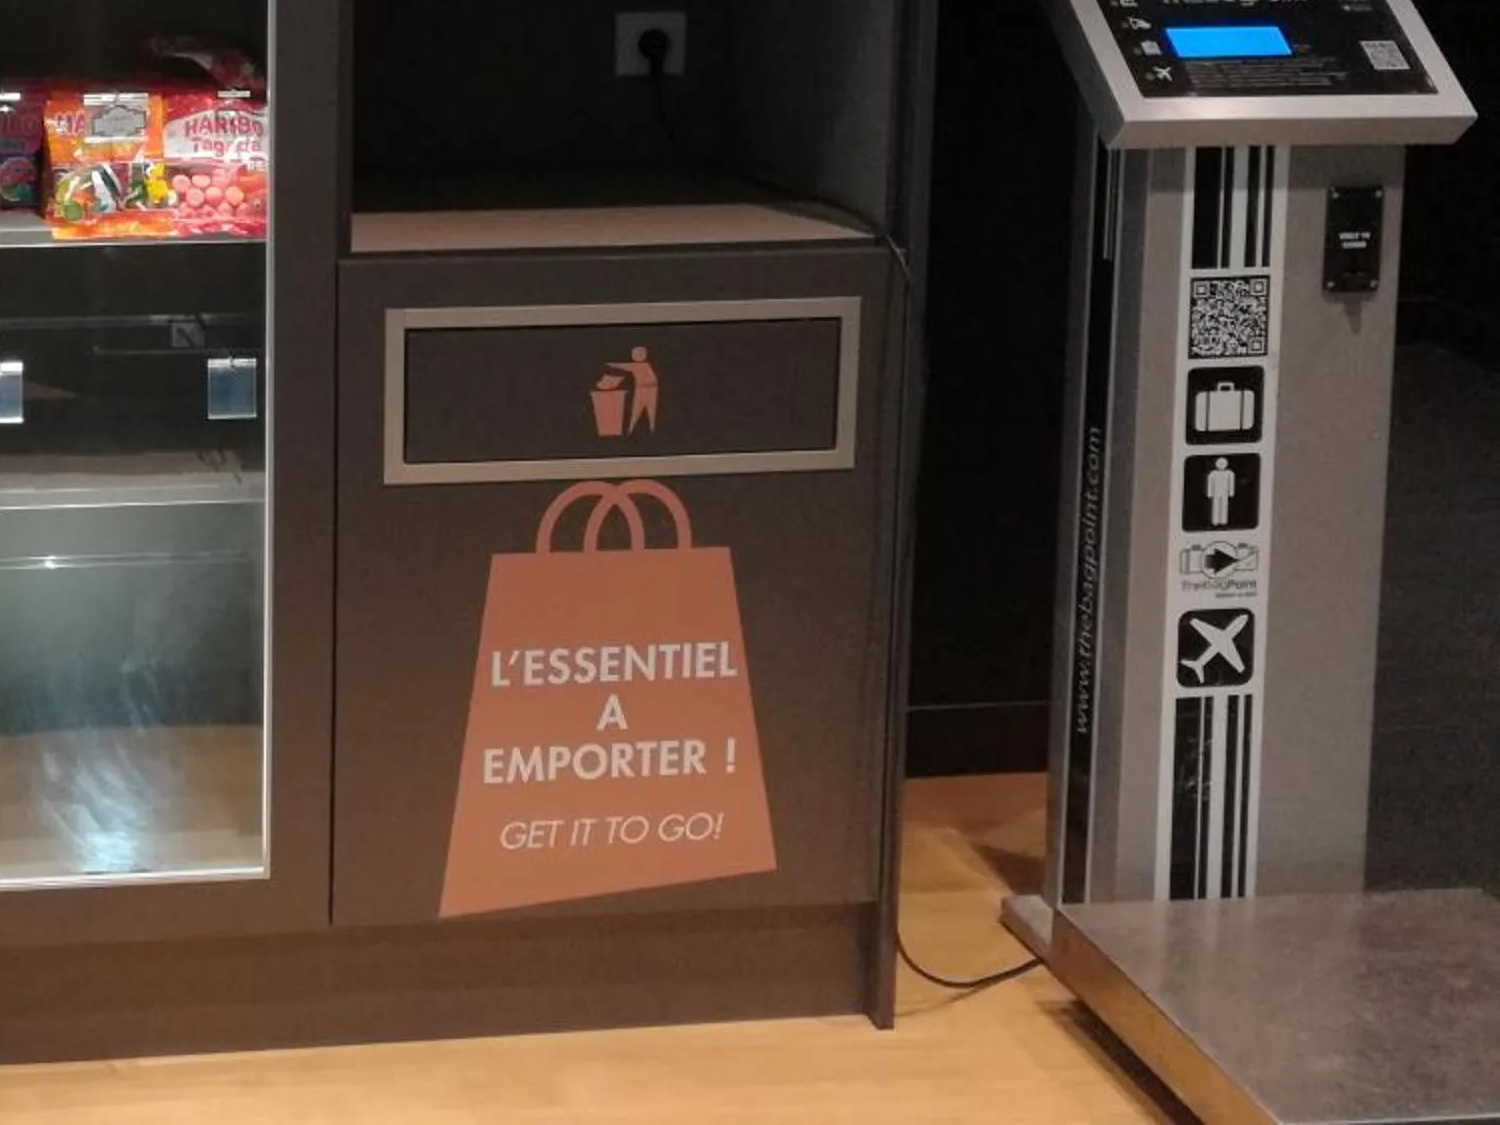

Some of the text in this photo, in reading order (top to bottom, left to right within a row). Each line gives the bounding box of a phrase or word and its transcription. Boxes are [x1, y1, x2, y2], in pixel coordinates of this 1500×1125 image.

[491, 641, 738, 687] L'ESSENTIEL
[596, 694, 629, 732] A
[483, 741, 708, 785] EMPORTER
[500, 812, 725, 851] GET IT TO GO!
